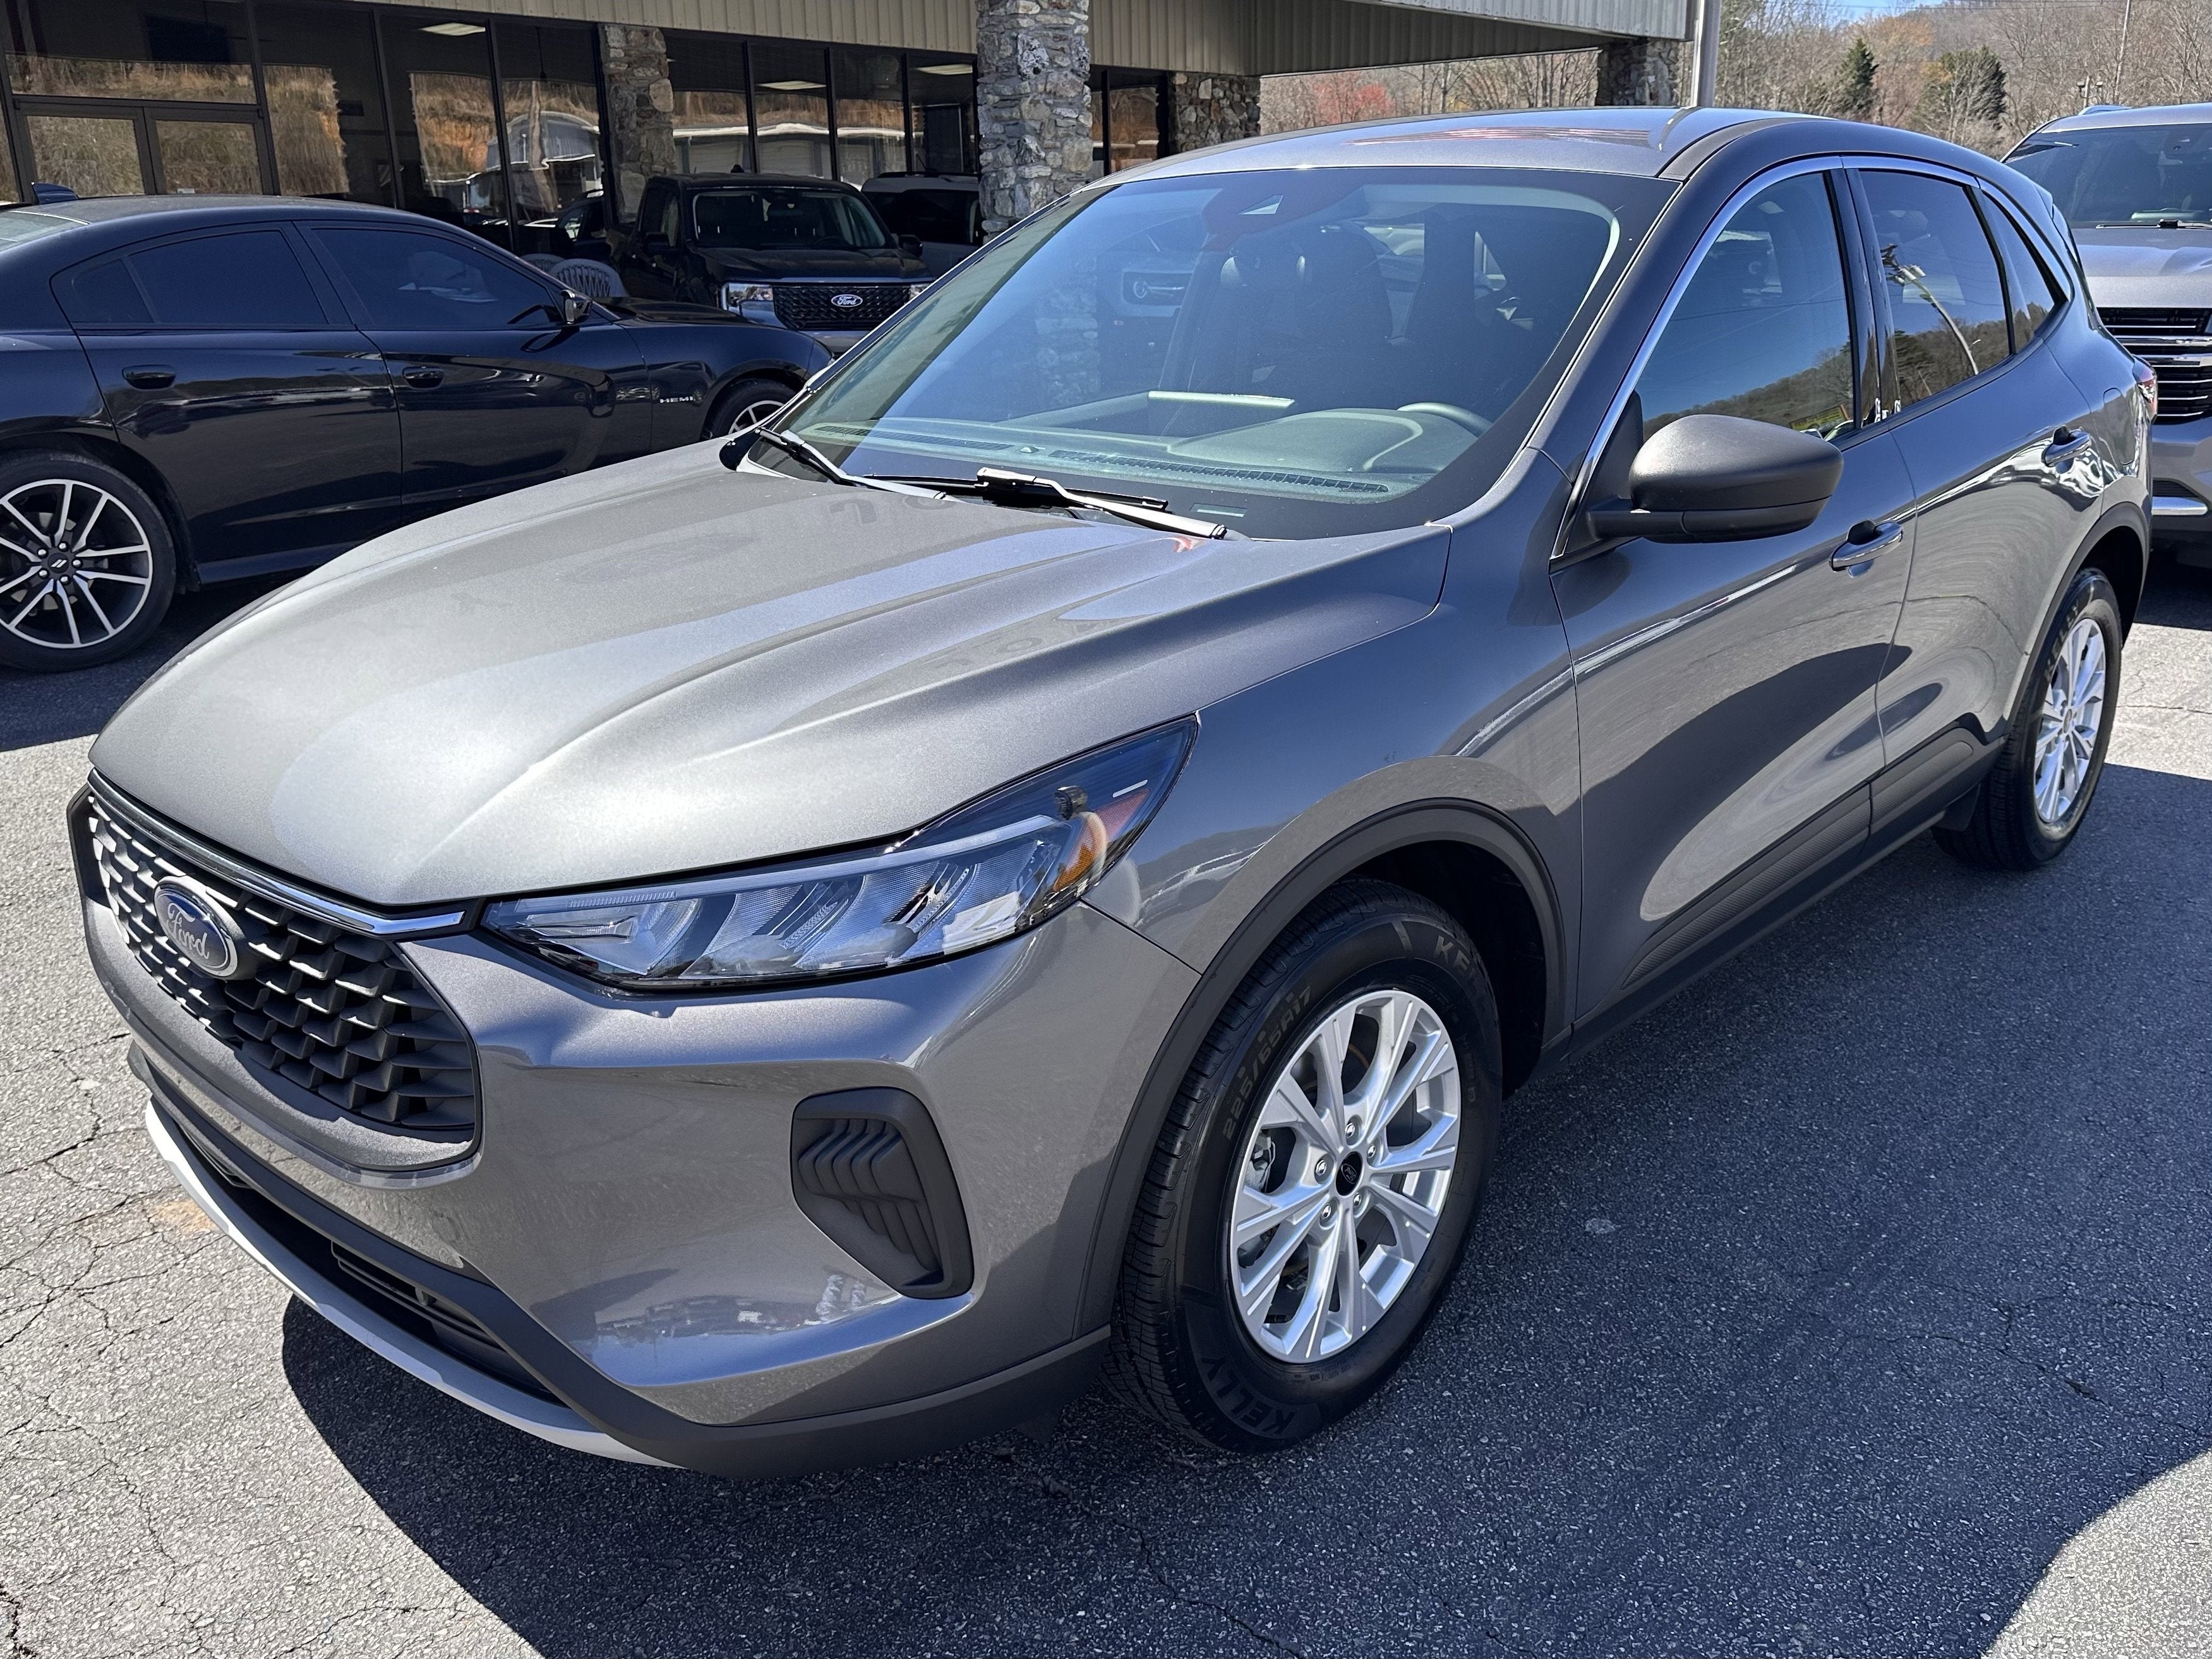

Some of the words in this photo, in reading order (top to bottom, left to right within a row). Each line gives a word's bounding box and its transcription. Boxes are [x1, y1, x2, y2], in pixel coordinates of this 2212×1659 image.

[167, 902, 210, 960] Ford
[1223, 985, 1311, 1140] 225/65R17
[1201, 1358, 1295, 1435] KELLY
